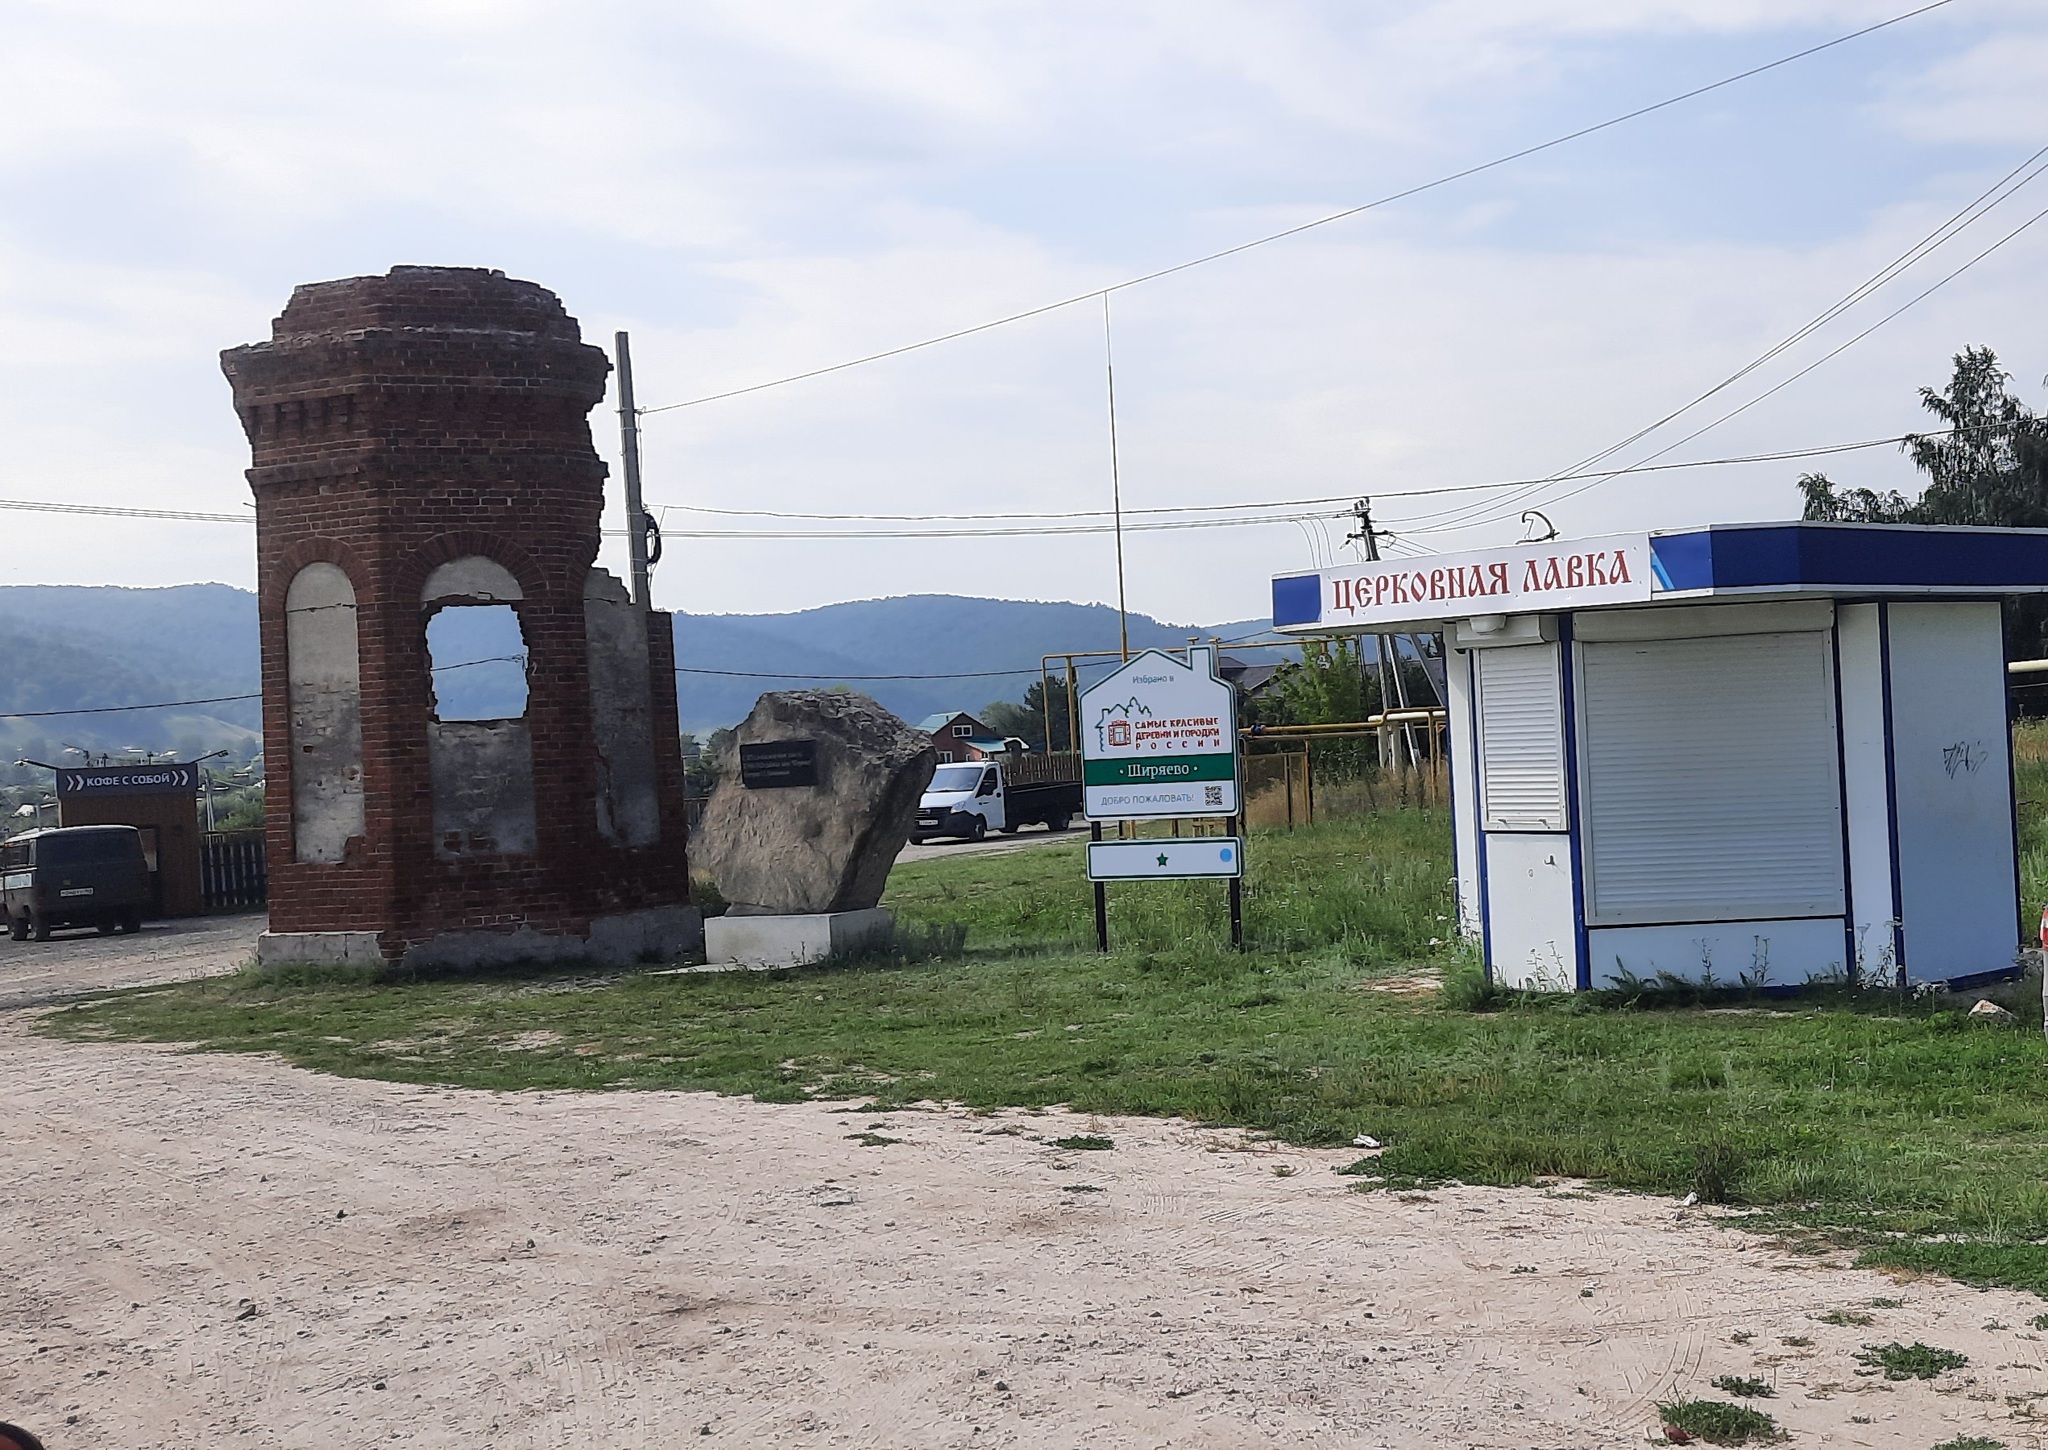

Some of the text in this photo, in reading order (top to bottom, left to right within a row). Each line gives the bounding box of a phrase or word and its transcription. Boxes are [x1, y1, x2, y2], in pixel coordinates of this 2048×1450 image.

[1332, 550, 1632, 618] ЦЕРКОВНАЯ ЛАВКА
[1132, 674, 1168, 685] Избрано
[1135, 717, 1219, 729] САМЫЕ КРАСИВЫЕ
[1135, 728, 1220, 741] ДЕРЕВНИ И ГОРОДКИ
[1135, 739, 1220, 750] РОССИИ
[1128, 764, 1189, 779] Ширяево
[86, 773, 170, 787] КОФЕ С СОБОЙ
[1101, 793, 1194, 806] ДОБРО ПОЖАЛОВАТЬ!
